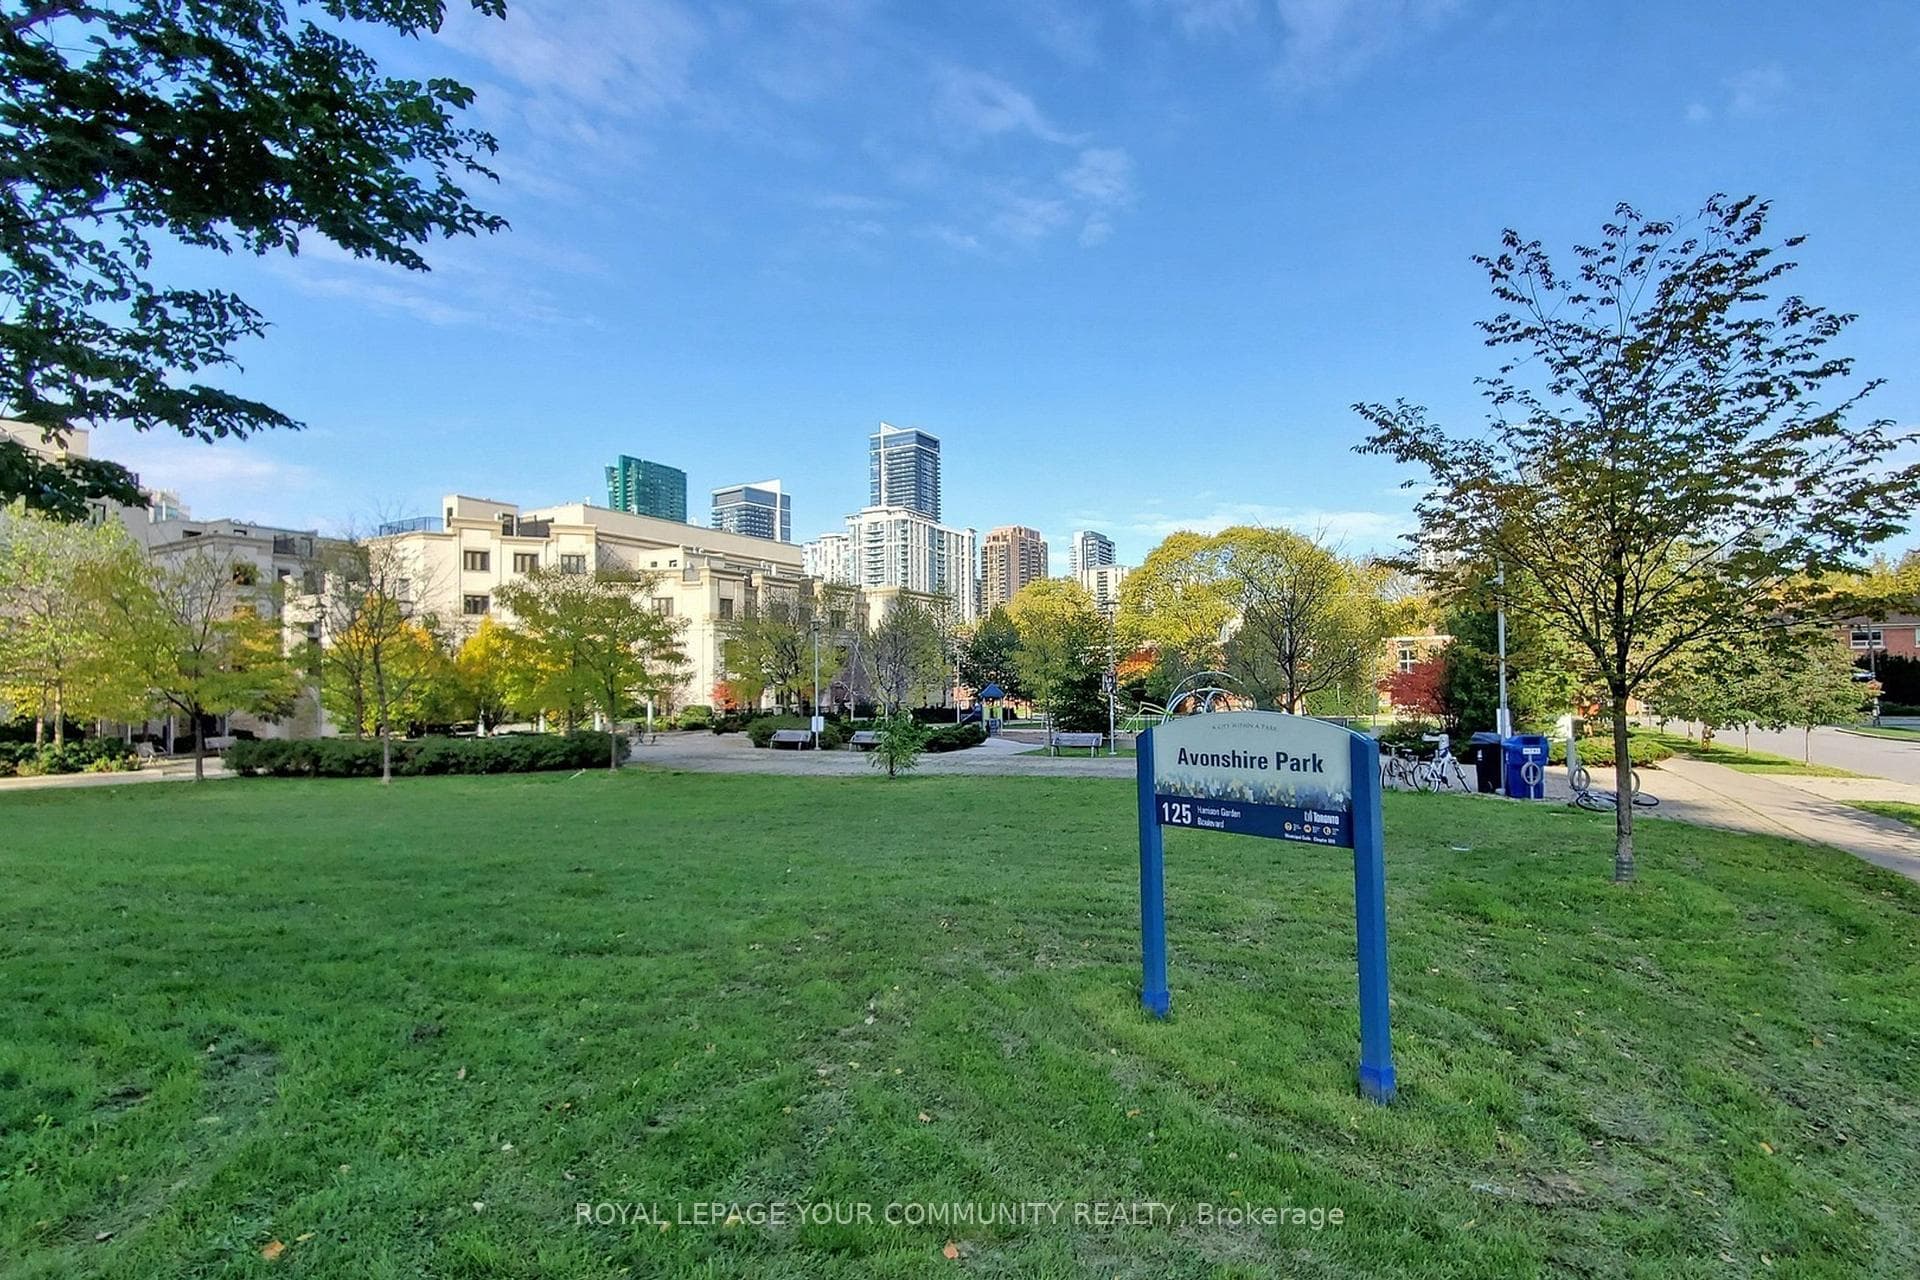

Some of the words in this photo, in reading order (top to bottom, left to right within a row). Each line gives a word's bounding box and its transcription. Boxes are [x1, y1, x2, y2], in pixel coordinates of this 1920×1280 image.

[1177, 747, 1269, 770] Avonshire
[1275, 751, 1324, 773] Park
[1162, 801, 1192, 824] 125
